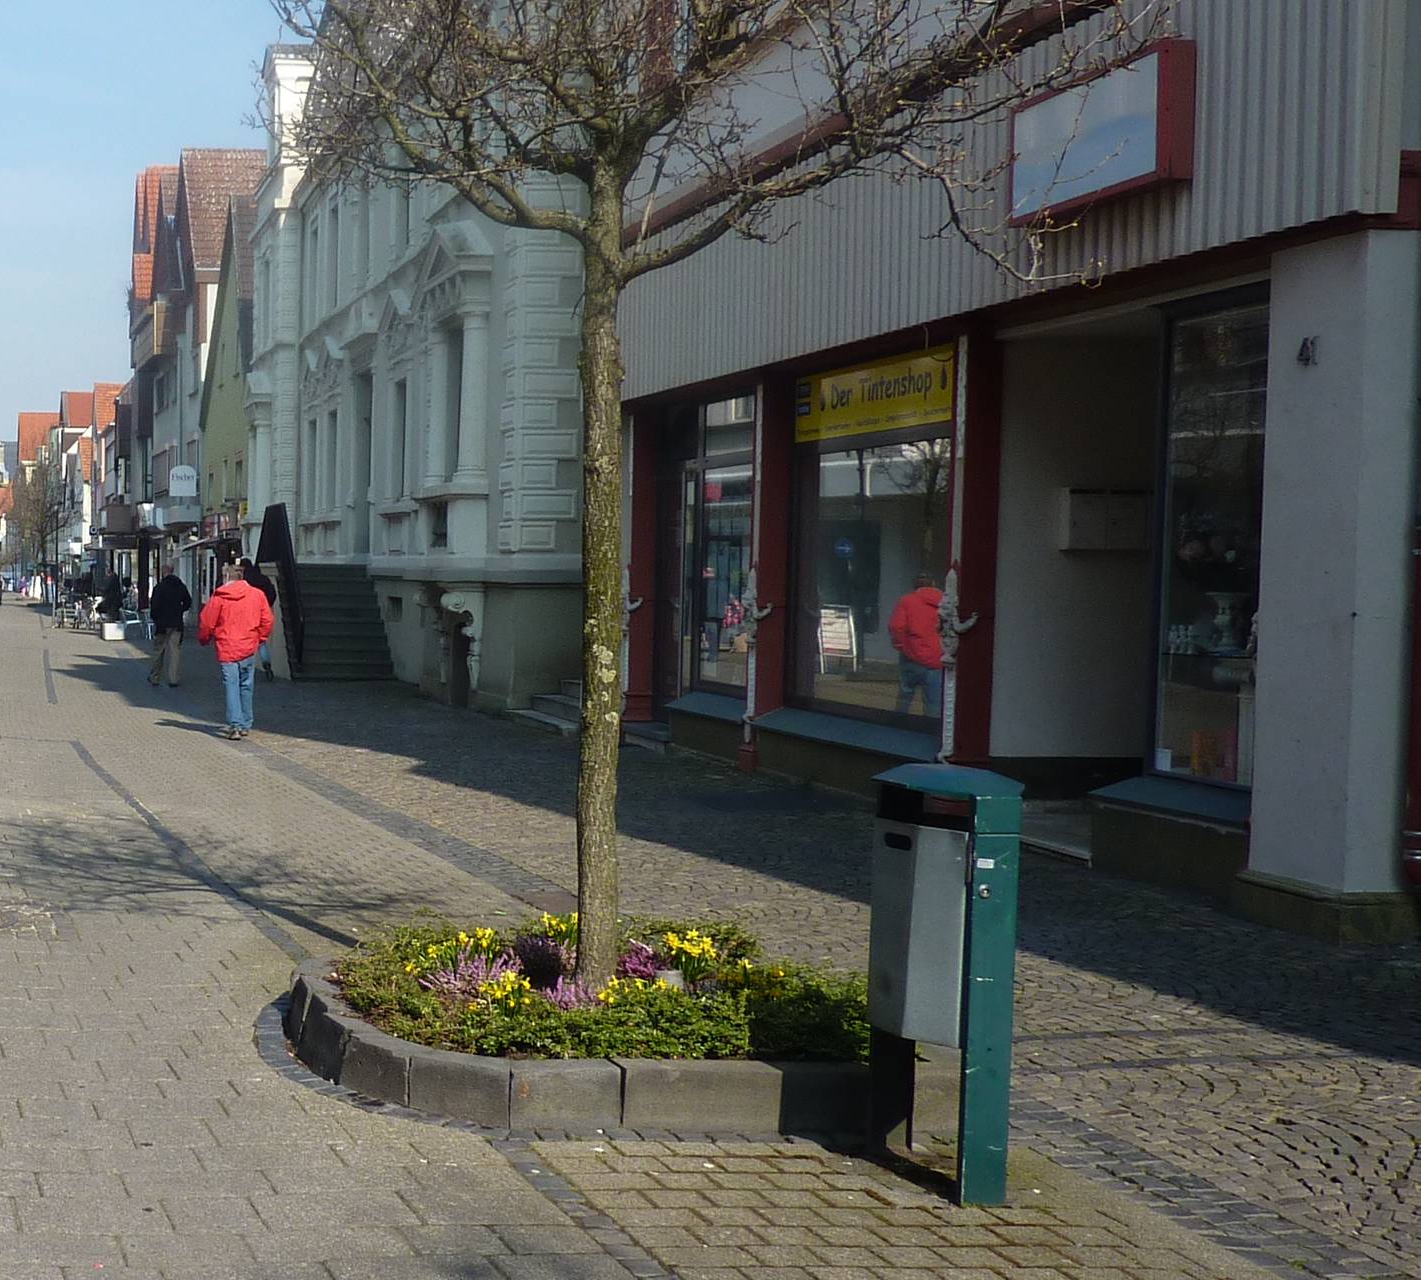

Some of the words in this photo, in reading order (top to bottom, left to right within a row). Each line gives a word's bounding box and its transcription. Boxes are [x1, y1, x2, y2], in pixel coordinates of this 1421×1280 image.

[1296, 335, 1320, 367] 41
[831, 383, 853, 410] Der
[858, 366, 932, 403] Tintenshop
